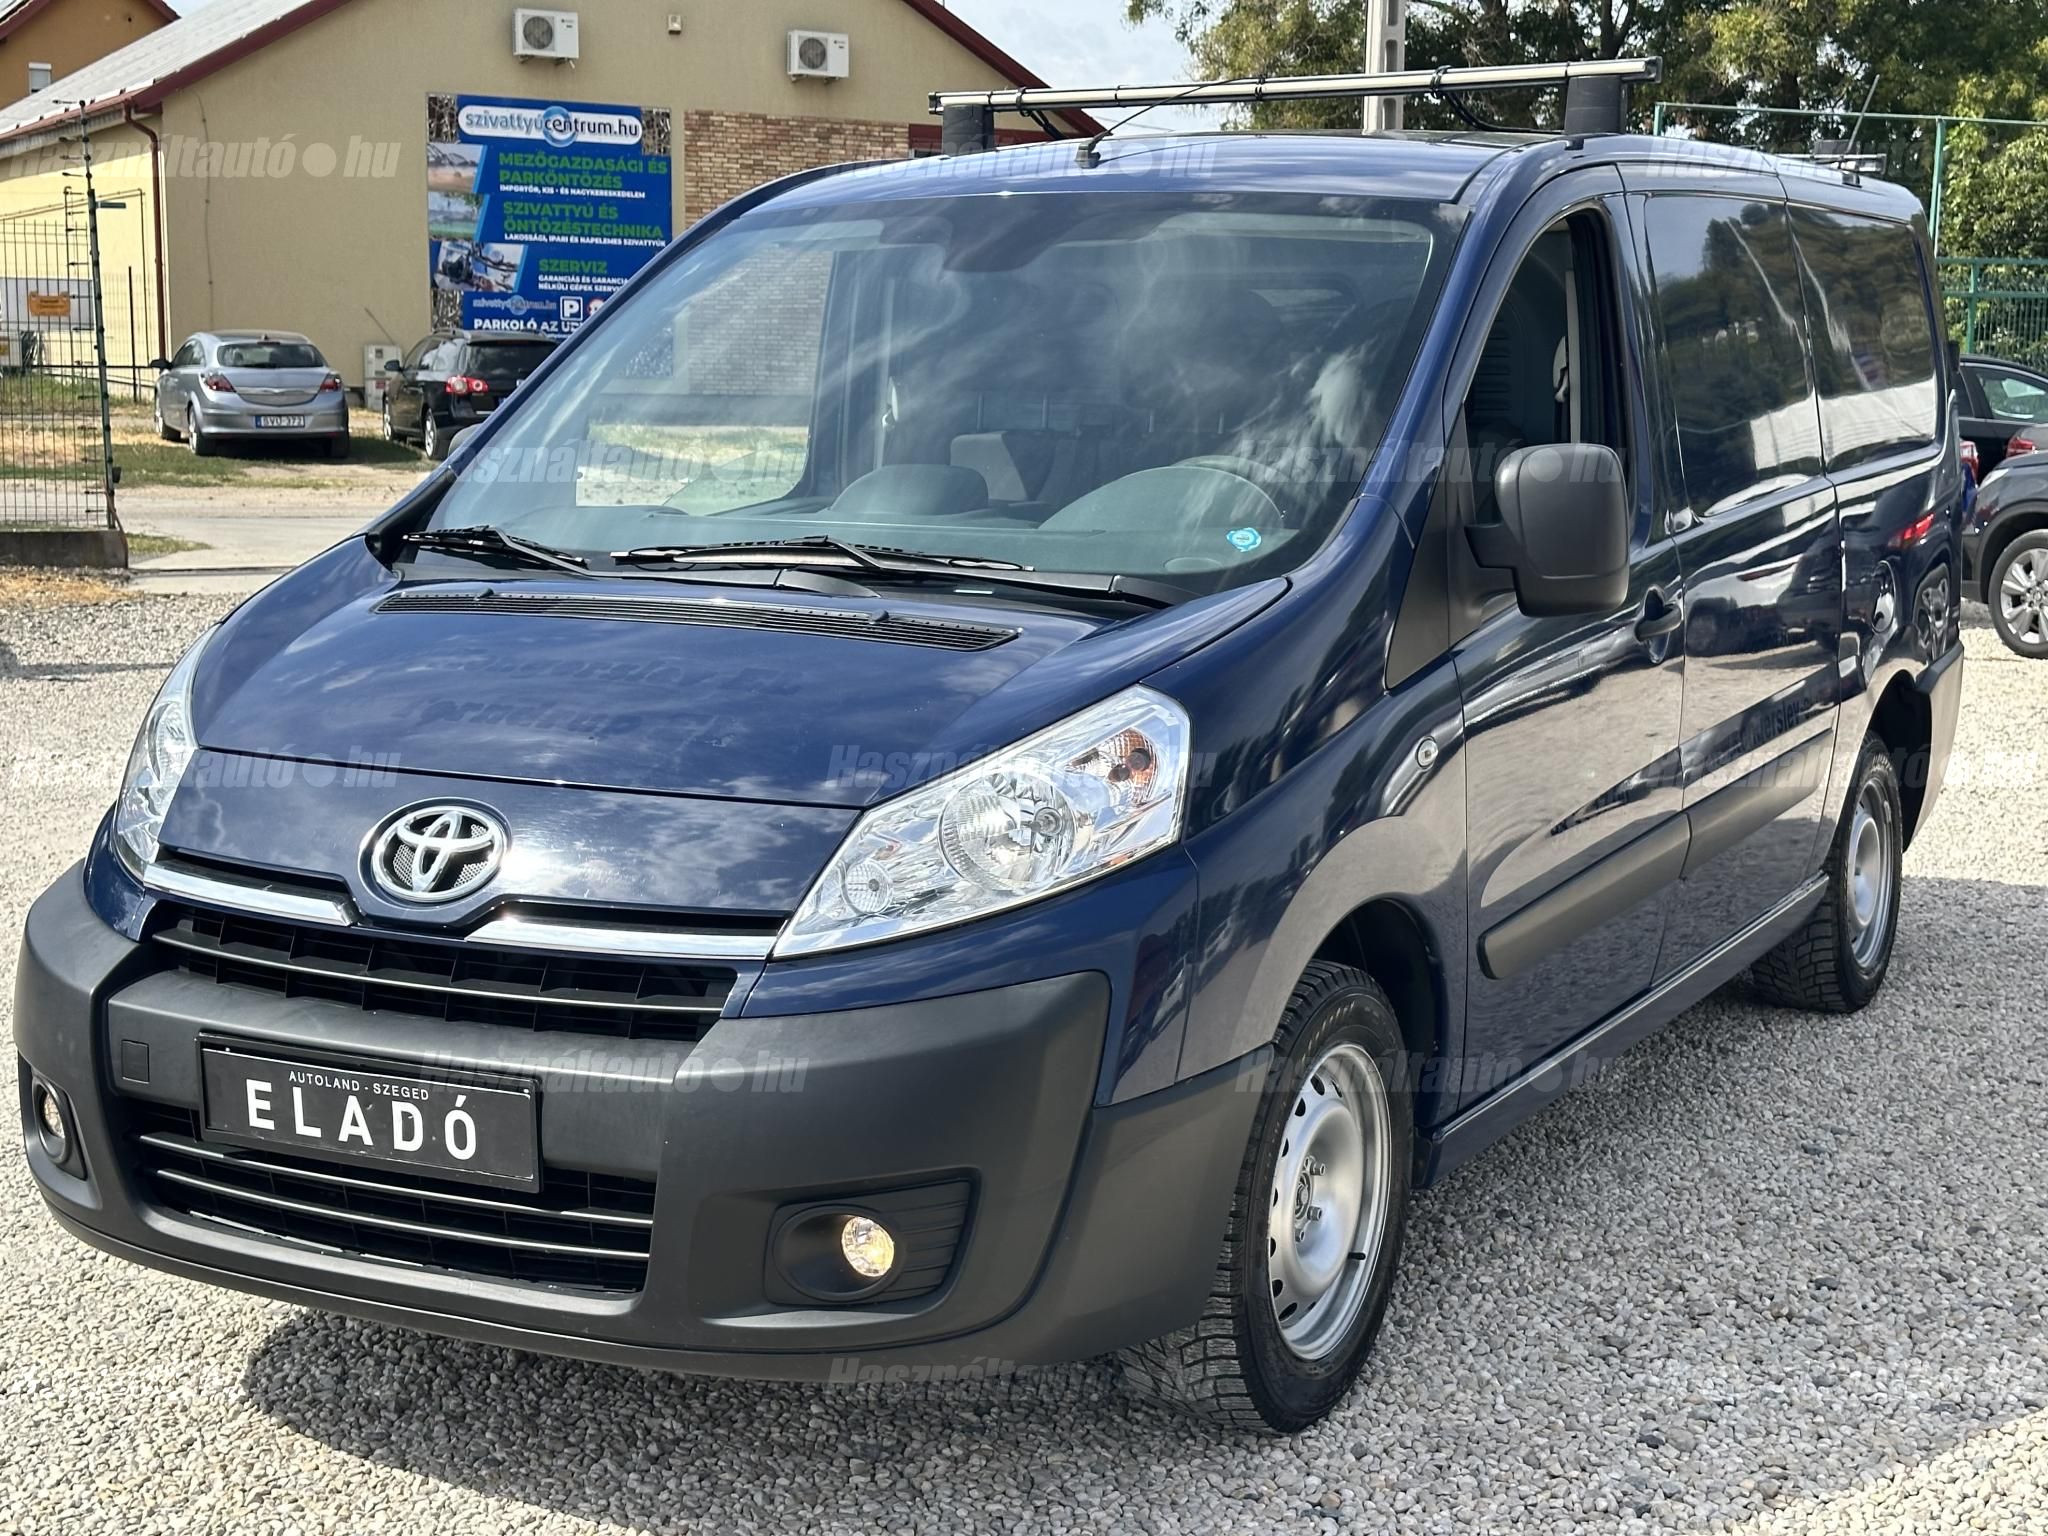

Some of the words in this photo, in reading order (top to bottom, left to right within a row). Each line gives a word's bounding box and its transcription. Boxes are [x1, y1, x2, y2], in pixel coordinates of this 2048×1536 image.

[465, 110, 640, 138] szivattyúcentrum.hu
[499, 150, 643, 173] MEZŐGAZDASÁGI
[647, 156, 668, 174] ÉS
[499, 168, 623, 189] PARKÖNTÖZÉS
[542, 186, 554, 195] KIS
[560, 186, 569, 195] ÉS
[503, 201, 593, 218] SZIVATTYÚ
[598, 203, 618, 219] ÉS
[503, 217, 663, 238] ÖNTÖZÉSTECHNIKA
[549, 236, 568, 244] IPARI
[569, 235, 579, 244] ÉS
[580, 237, 622, 246] NAPELEMES
[538, 258, 607, 274] SZERVIZ
[538, 274, 580, 284] GARANCIÁS
[581, 276, 590, 284] ÉS
[569, 284, 593, 292] GÉPEK
[594, 286, 621, 294] SZERVI
[474, 317, 537, 331] PARKOLÓ
[541, 321, 558, 332] AZ
[289, 1070, 360, 1092] AUTOLAND
[373, 1082, 430, 1101] SZEGED
[246, 1079, 477, 1161] ELADÓ
